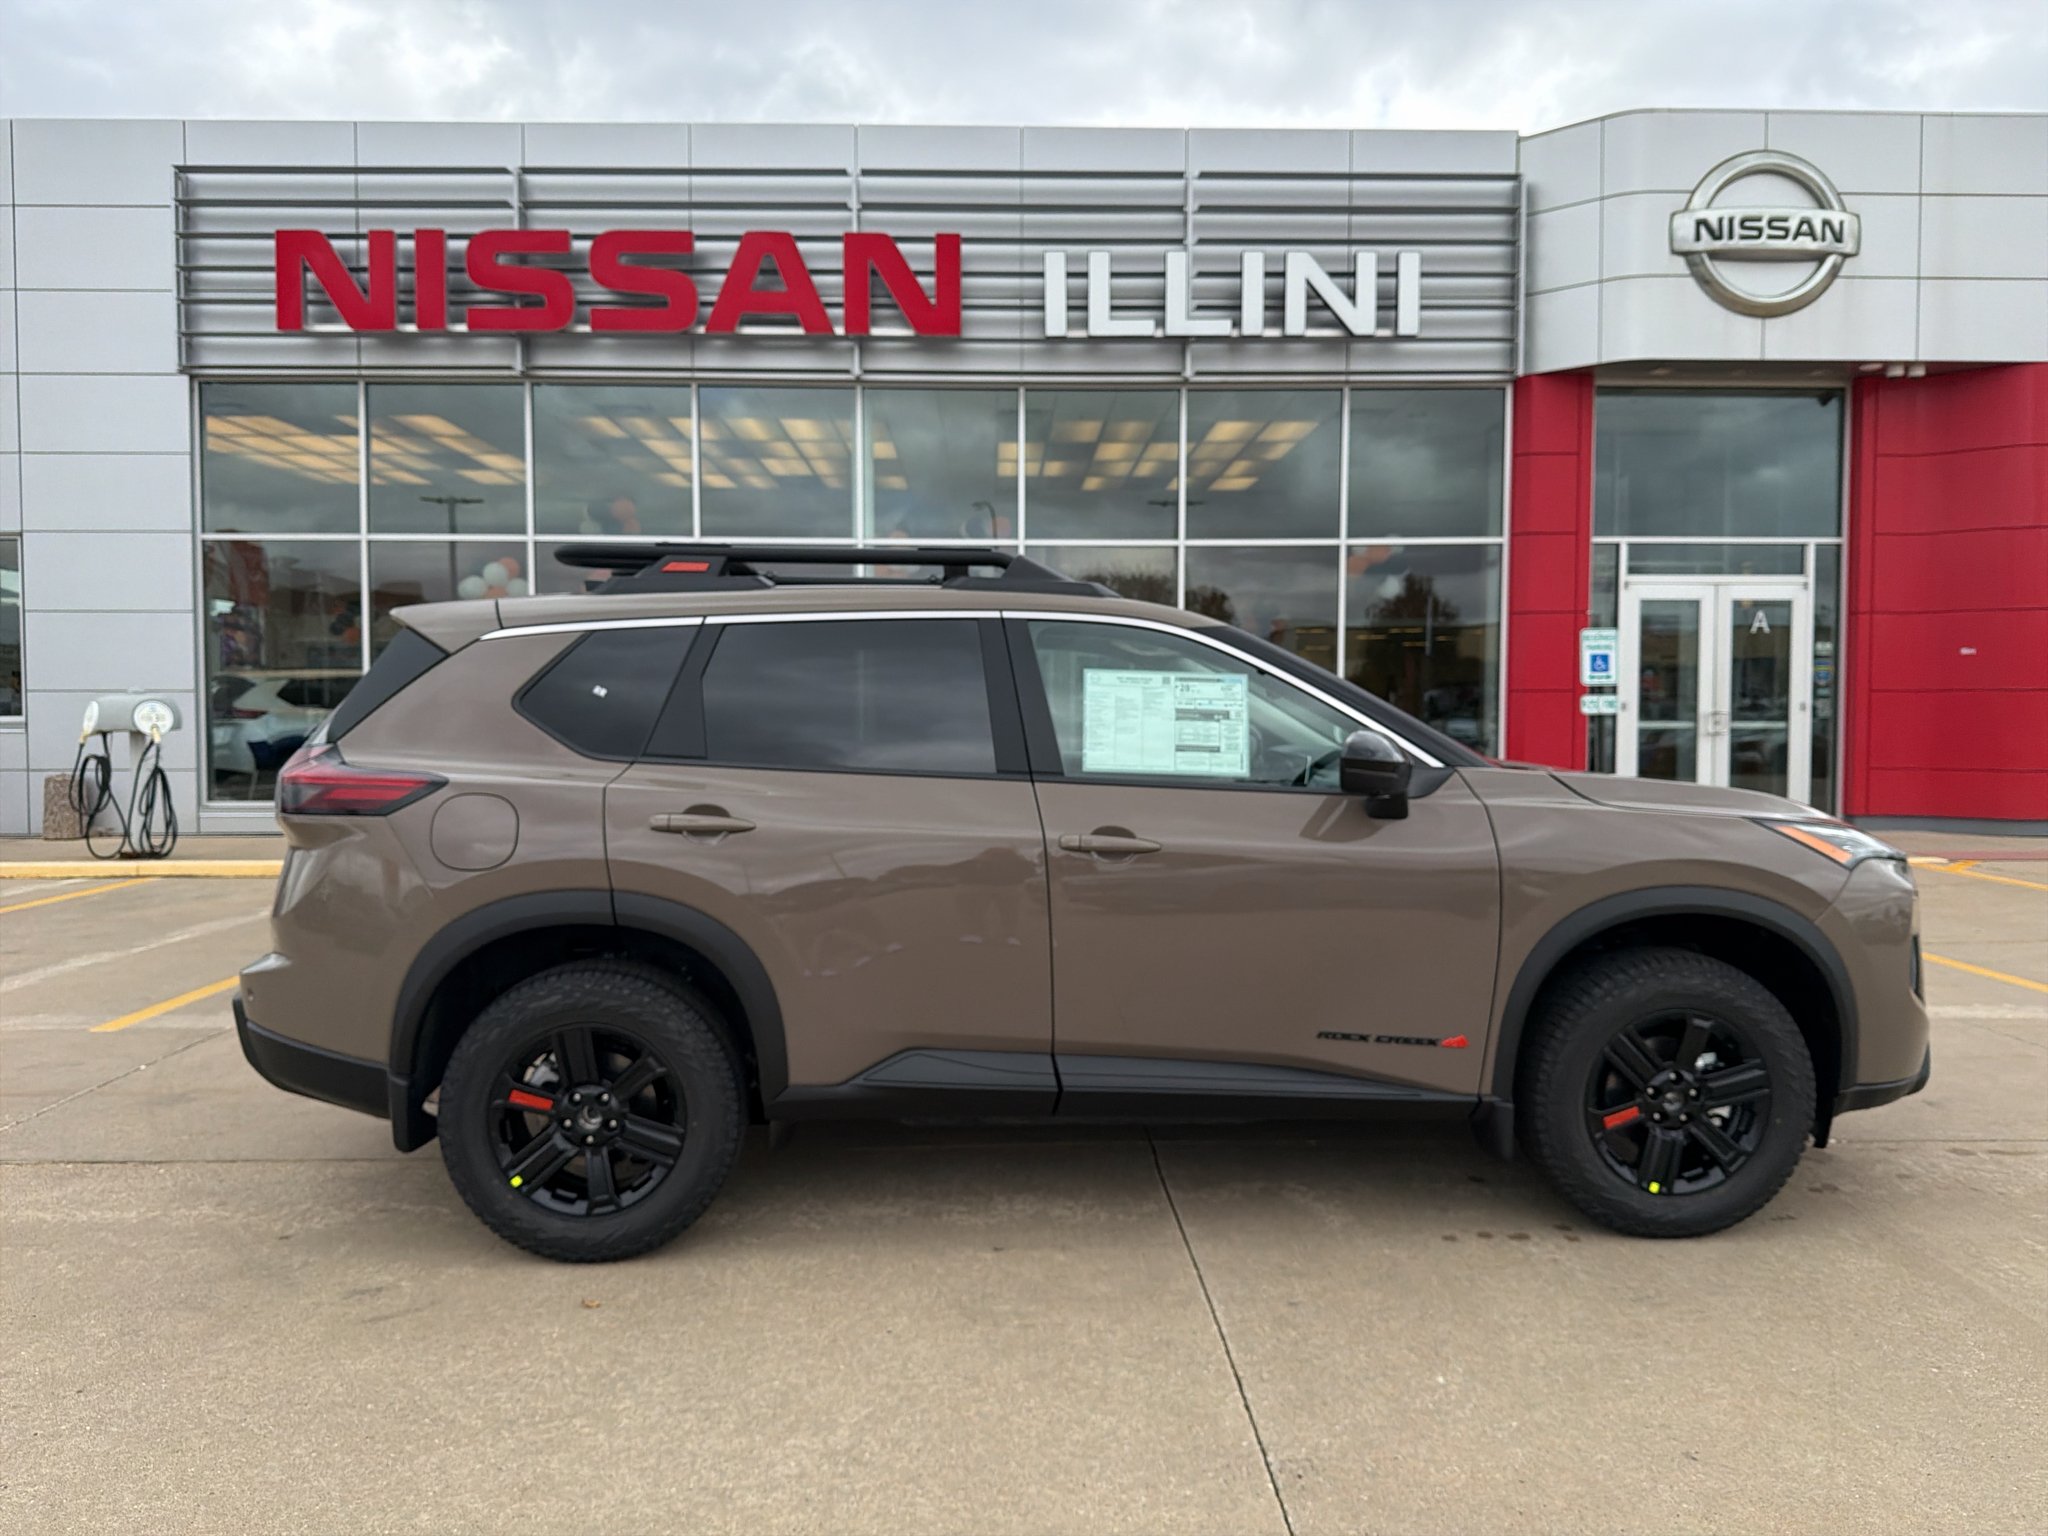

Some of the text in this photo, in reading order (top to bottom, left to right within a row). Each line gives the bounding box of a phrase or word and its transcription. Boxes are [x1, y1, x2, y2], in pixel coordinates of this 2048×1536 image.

[1694, 216, 1844, 243] NISSAN
[275, 229, 1421, 337] NISSAN ILLINI
[1750, 610, 1770, 634] A
[1317, 1031, 1438, 1047] ROCK CREEK
